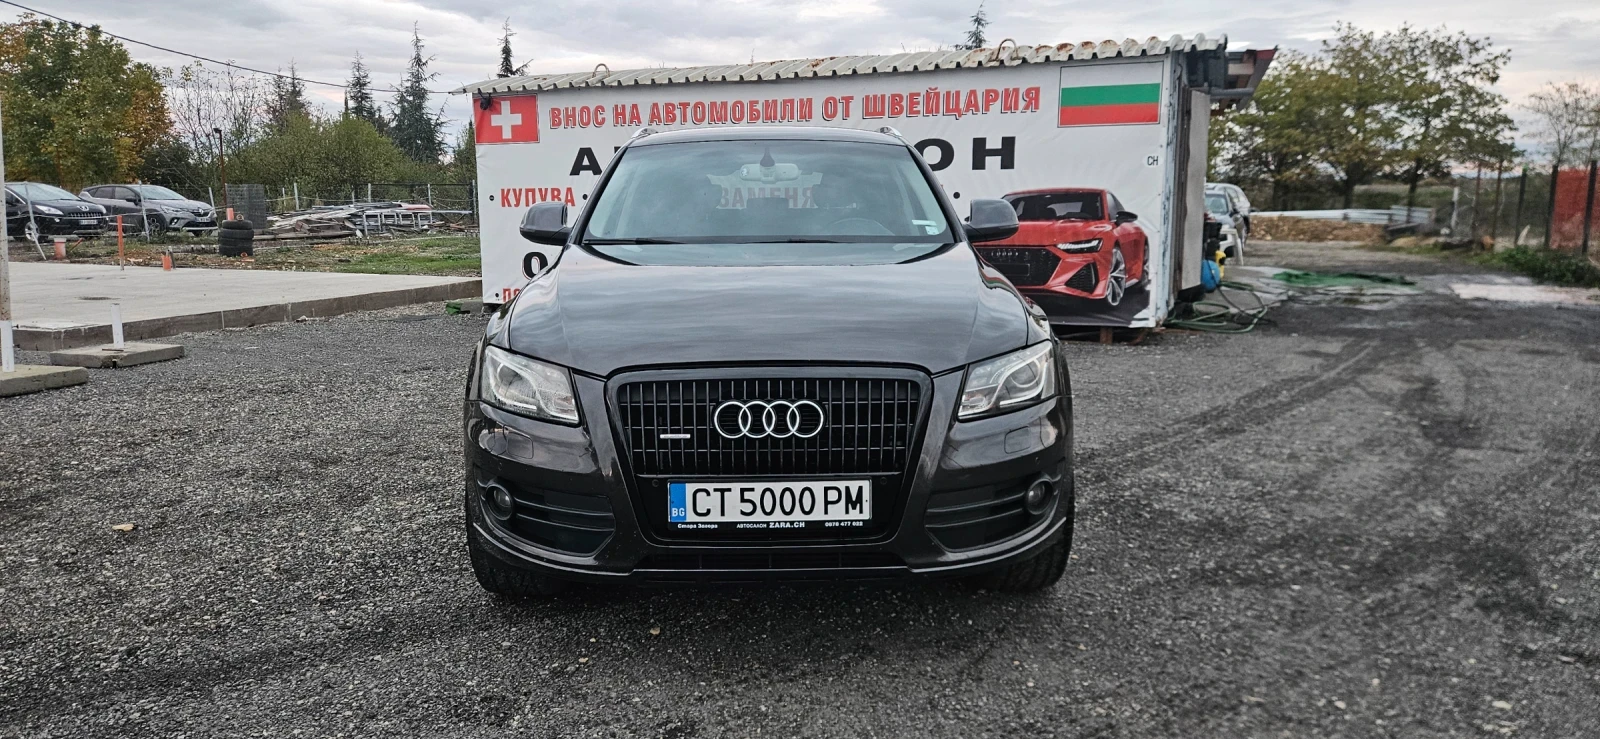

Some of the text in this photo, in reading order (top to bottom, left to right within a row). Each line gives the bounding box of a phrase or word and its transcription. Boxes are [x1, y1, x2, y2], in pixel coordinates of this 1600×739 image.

[549, 87, 1041, 129] ВНОС НА АВТОМОБИЛИ ОТ ШВЕЙЦАРИЯ
[914, 136, 1016, 171] ОН
[501, 187, 576, 207] КУПУВА
[672, 485, 864, 517] BG CT 5000 PM
